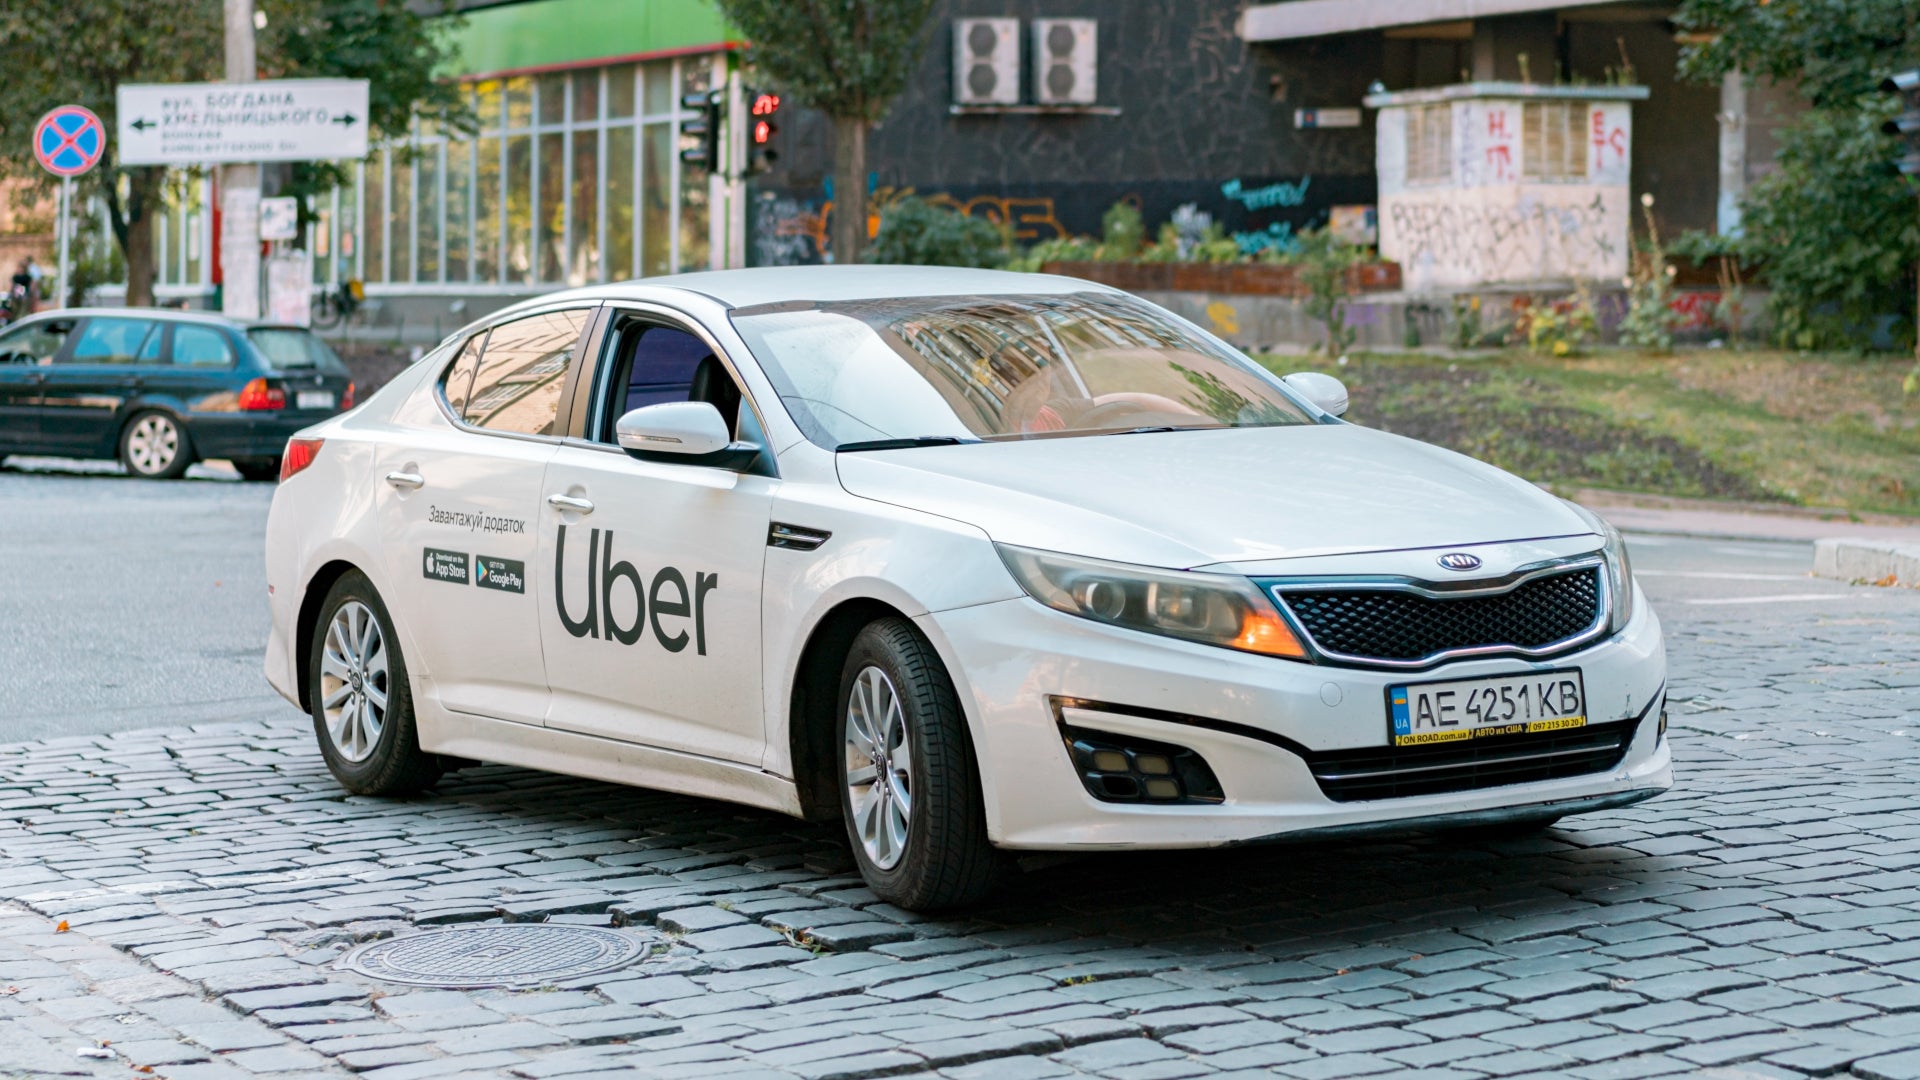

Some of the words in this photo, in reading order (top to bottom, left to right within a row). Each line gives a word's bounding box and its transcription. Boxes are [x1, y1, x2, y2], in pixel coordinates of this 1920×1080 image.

[206, 92, 295, 109] БОГДАНА
[428, 505, 483, 532] Завантажуй
[484, 516, 525, 534] додаток
[436, 562, 448, 578] App
[449, 563, 466, 579] Store
[489, 570, 509, 587] Google
[510, 573, 522, 590] Play
[555, 524, 718, 656] Uber
[1415, 691, 1459, 728] AE
[1466, 684, 1531, 723] 4251
[1538, 680, 1579, 717] KB
[1395, 718, 1409, 730] UA
[1476, 727, 1495, 737] АВТО
[1505, 725, 1523, 734] США
[1533, 722, 1545, 730] 097
[1404, 736, 1416, 744] ON
[1417, 732, 1467, 743] ROAD.com.ua
